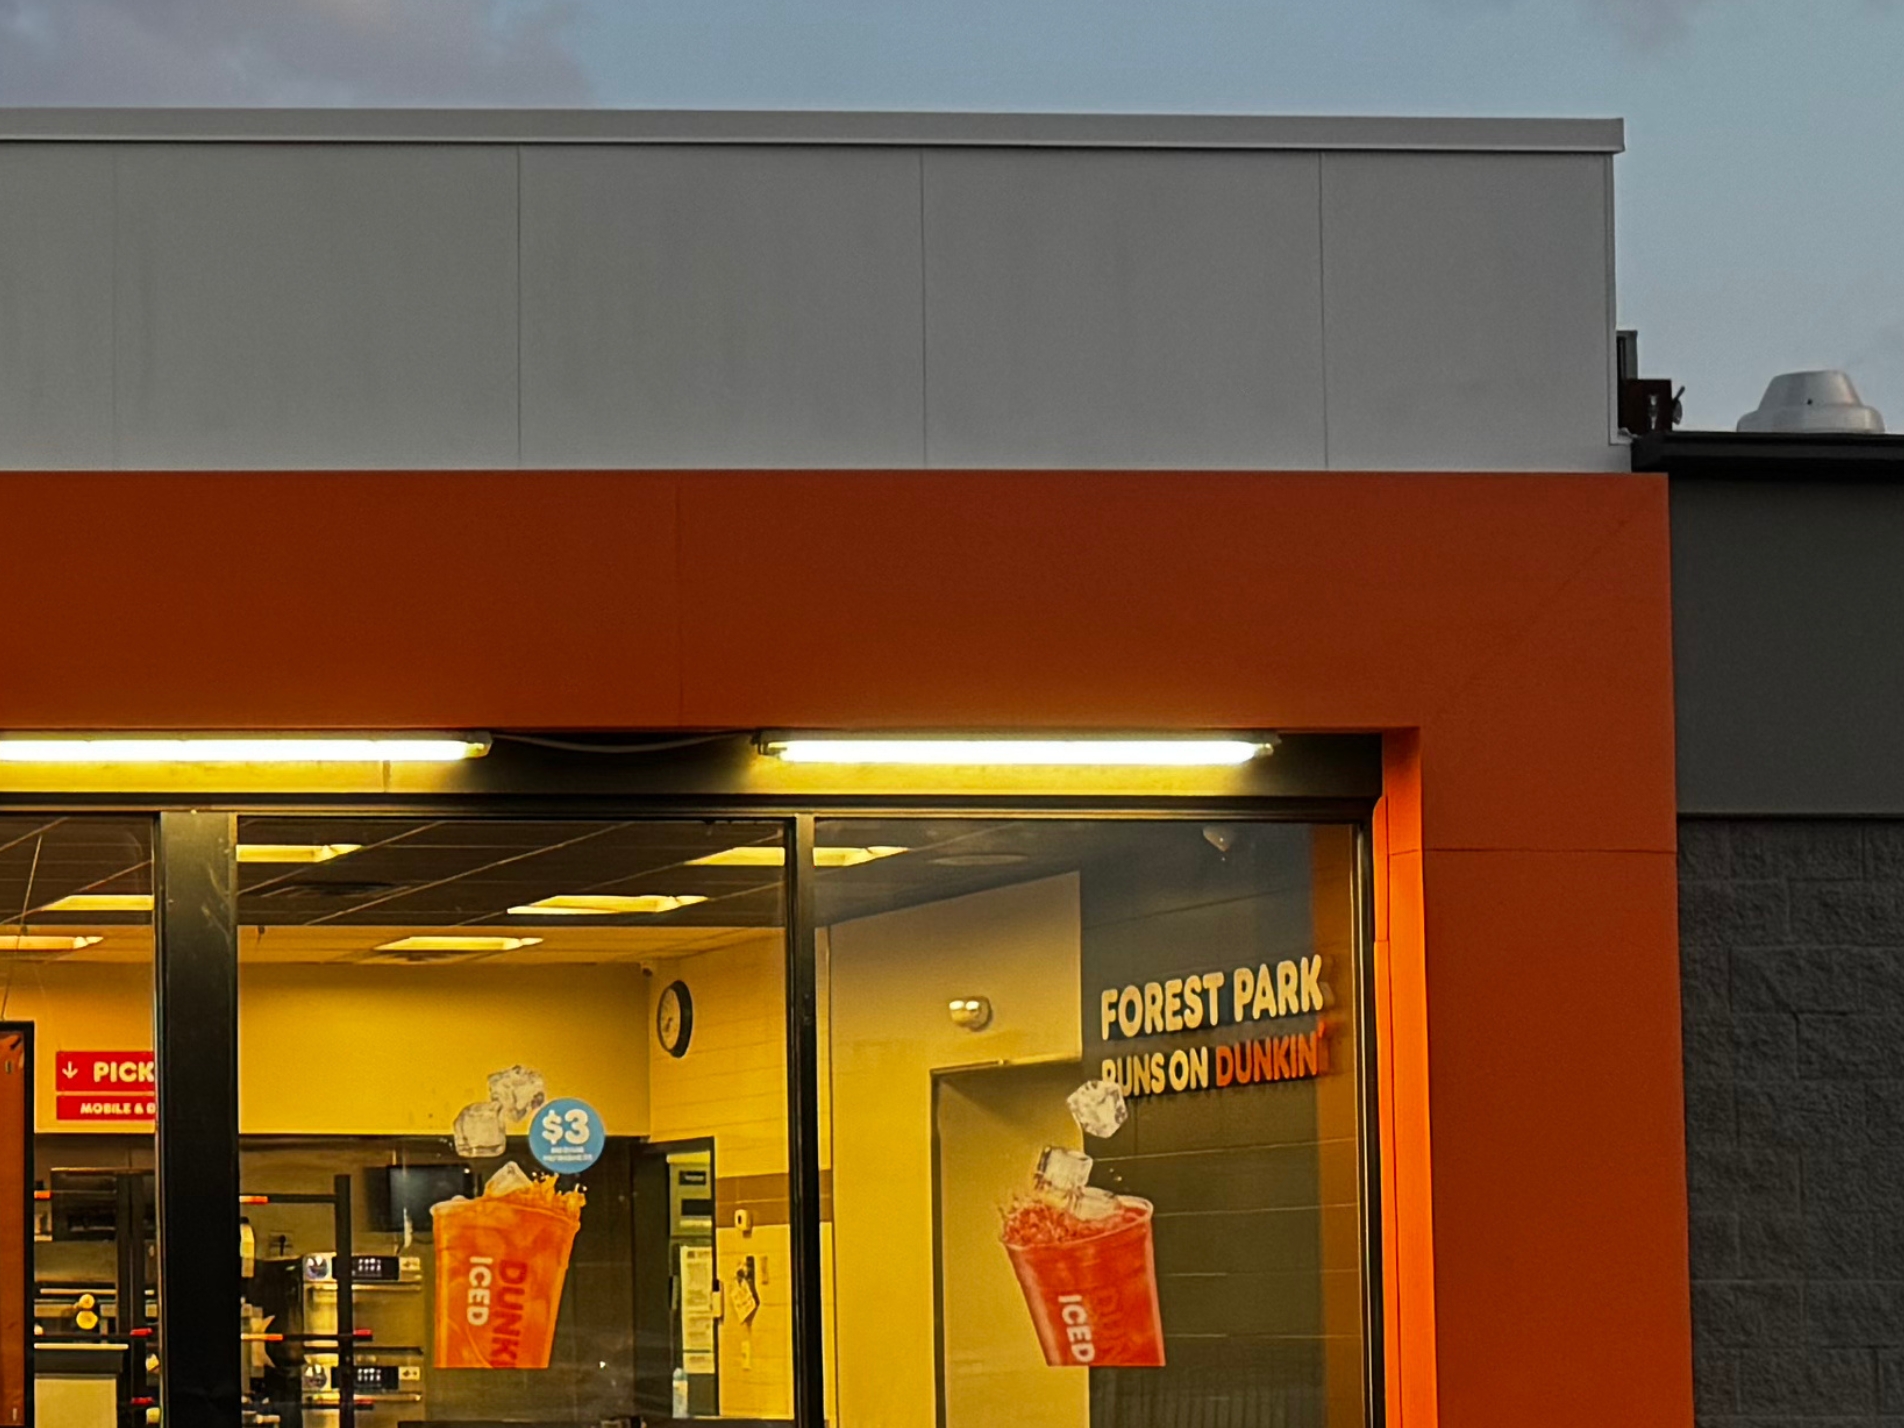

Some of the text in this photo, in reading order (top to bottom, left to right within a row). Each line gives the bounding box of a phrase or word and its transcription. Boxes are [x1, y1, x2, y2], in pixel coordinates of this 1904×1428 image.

[1102, 954, 1324, 1040] FOREST PARK
[93, 1061, 155, 1083] PICK
[1168, 1046, 1209, 1091] ON
[1215, 1021, 1326, 1087] DUNKIN'
[80, 1102, 131, 1115] MOBILE
[542, 1109, 590, 1145] $3
[466, 1255, 494, 1326] ICED
[1057, 1294, 1095, 1363] ICED
